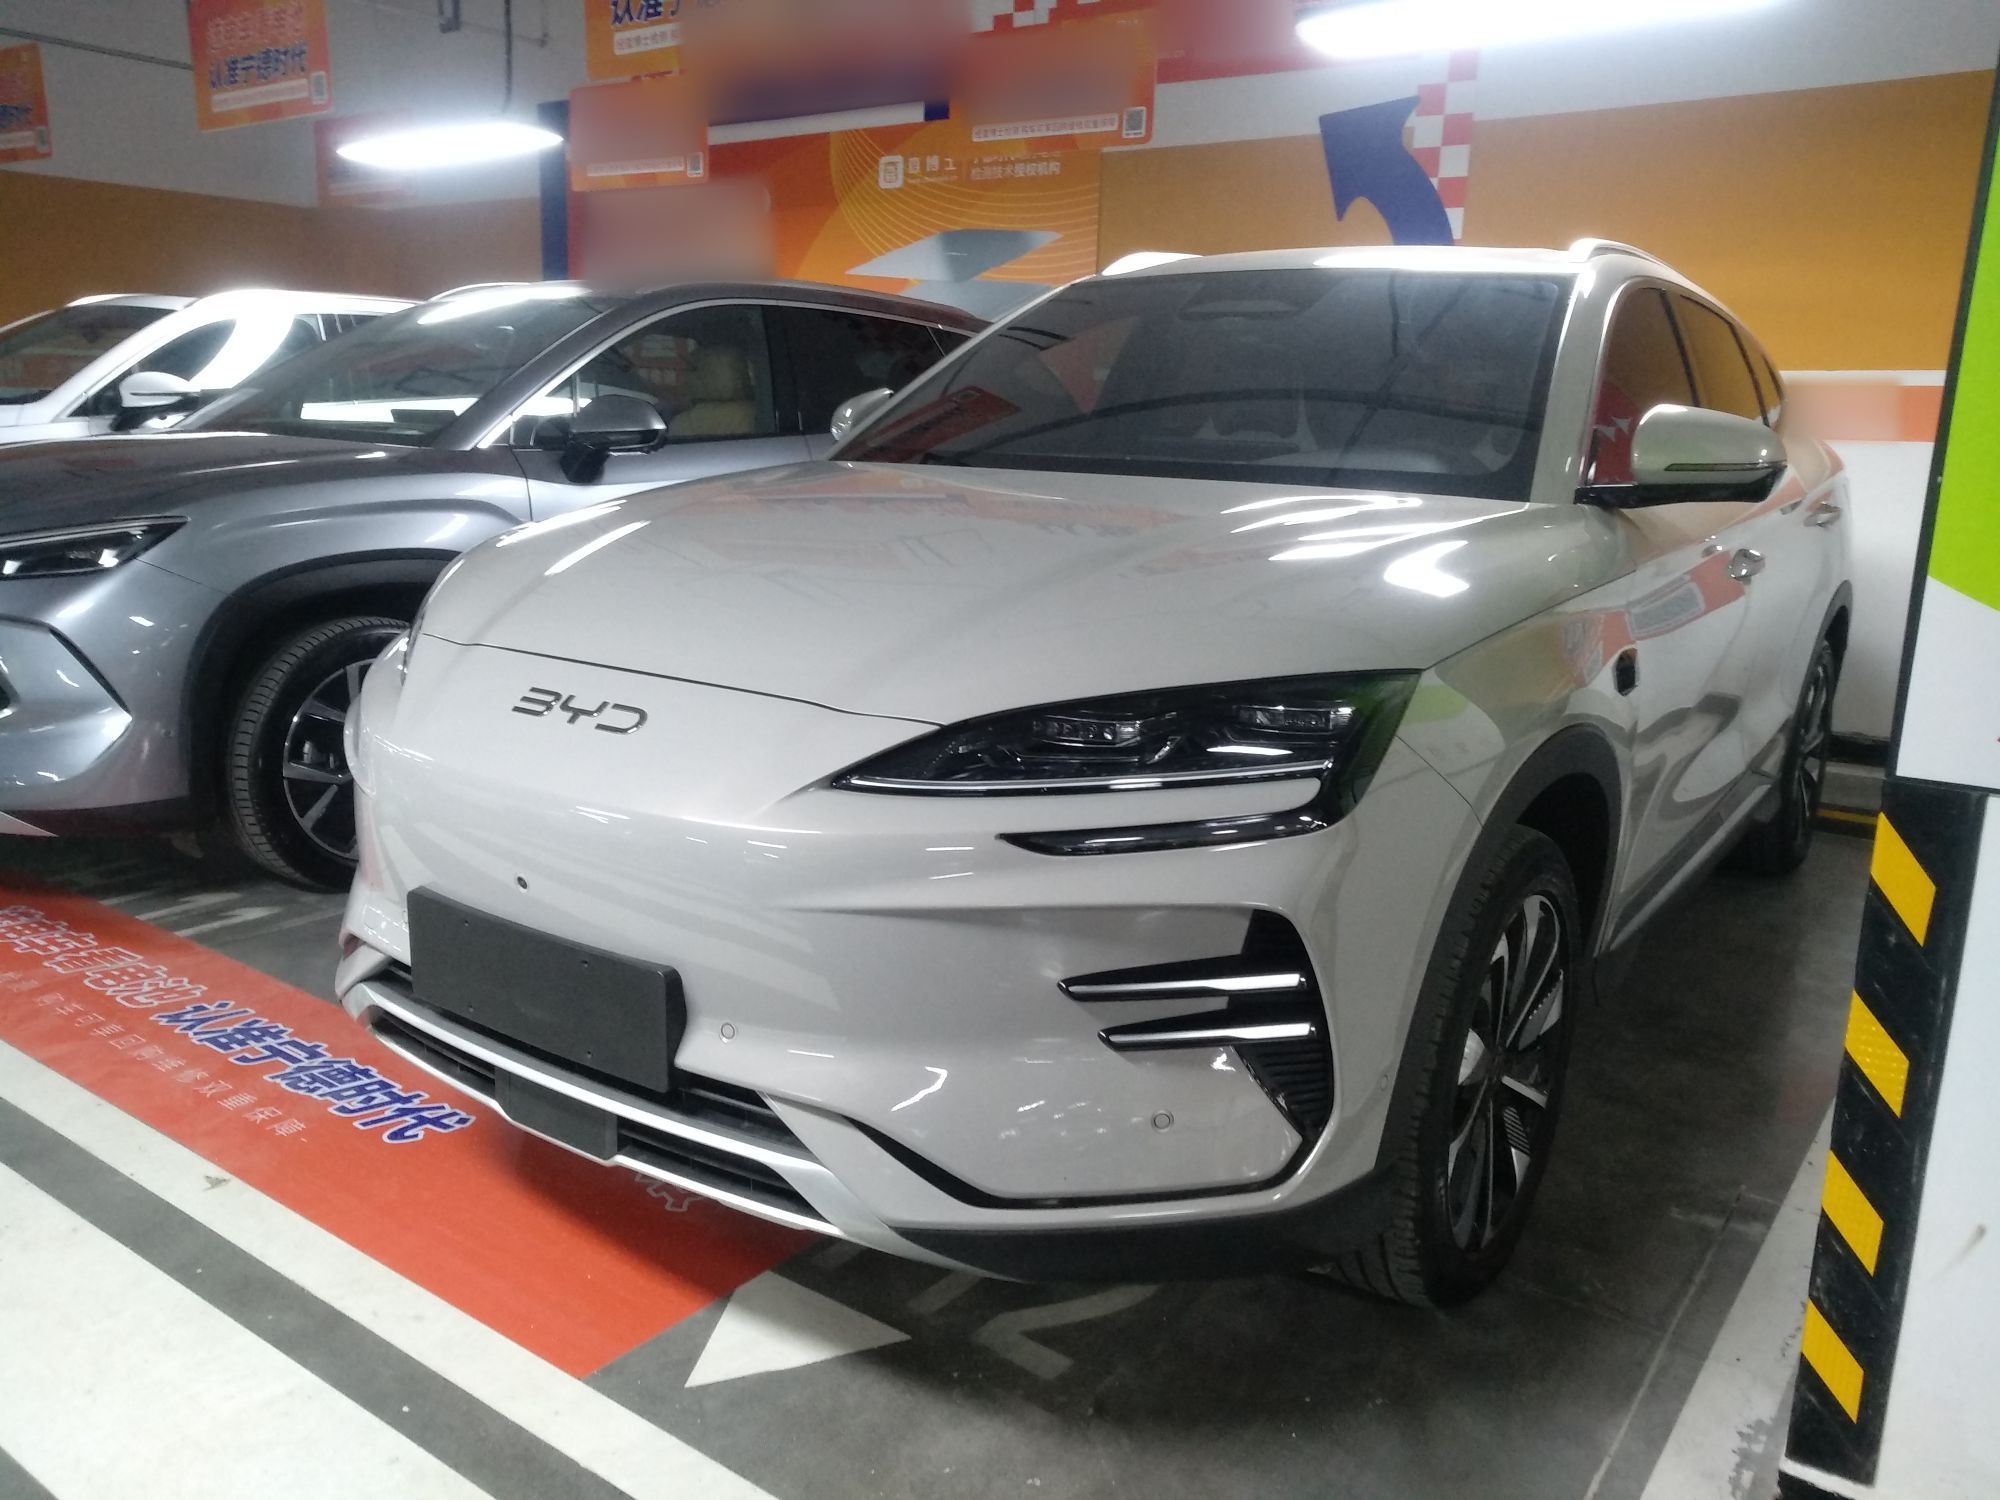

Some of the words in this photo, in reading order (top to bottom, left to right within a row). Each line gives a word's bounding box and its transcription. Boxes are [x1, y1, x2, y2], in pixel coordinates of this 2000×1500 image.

[511, 686, 648, 735] BYD
[148, 999, 476, 1144] 认准宁德时代
